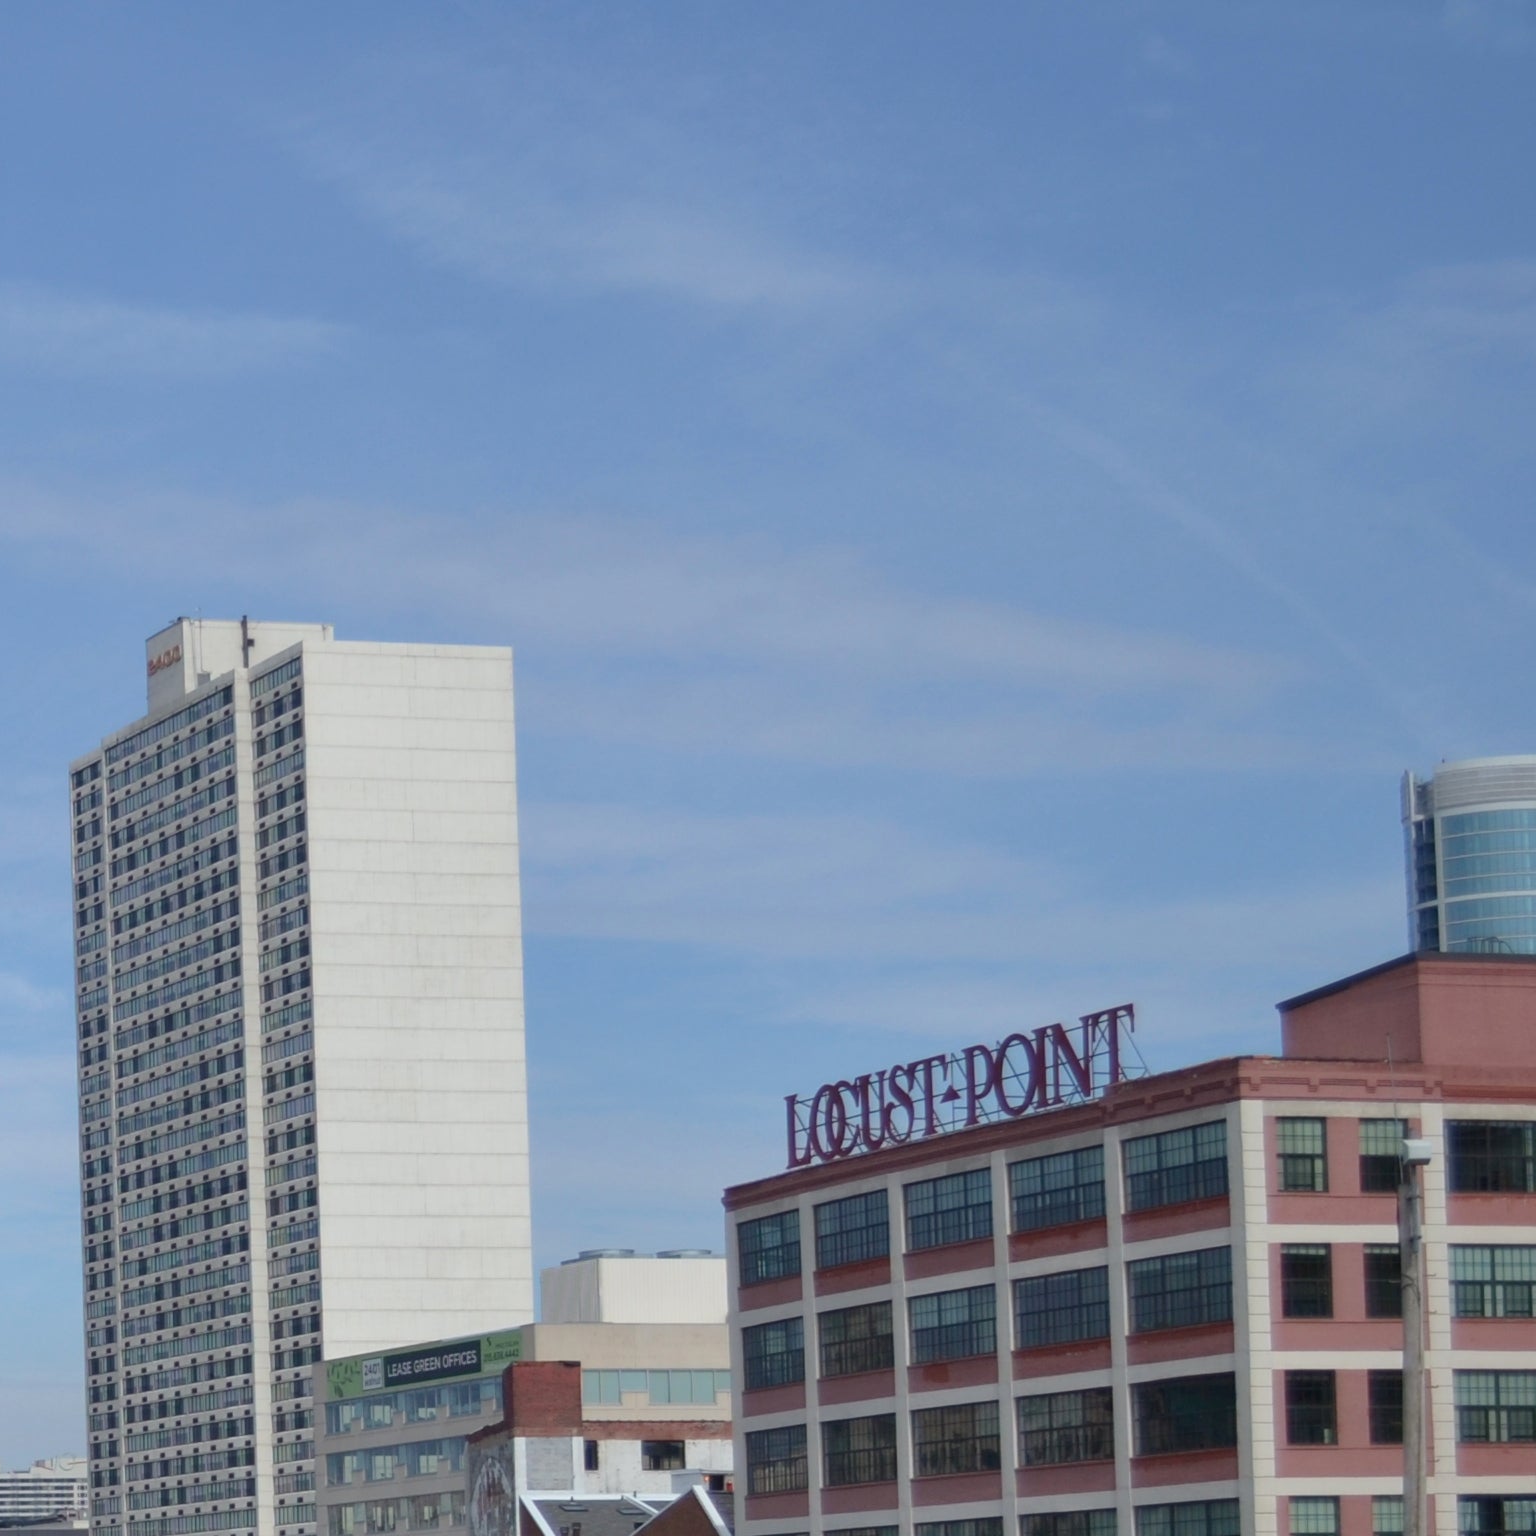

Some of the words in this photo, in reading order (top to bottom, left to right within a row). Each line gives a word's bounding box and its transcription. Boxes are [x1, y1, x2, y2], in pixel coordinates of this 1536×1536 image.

[784, 1053, 948, 1170] LOCUST
[962, 1003, 1136, 1127] POINT
[387, 1361, 413, 1378] LEASE
[413, 1356, 441, 1373] GREEN
[442, 1350, 477, 1369] OFFICES
